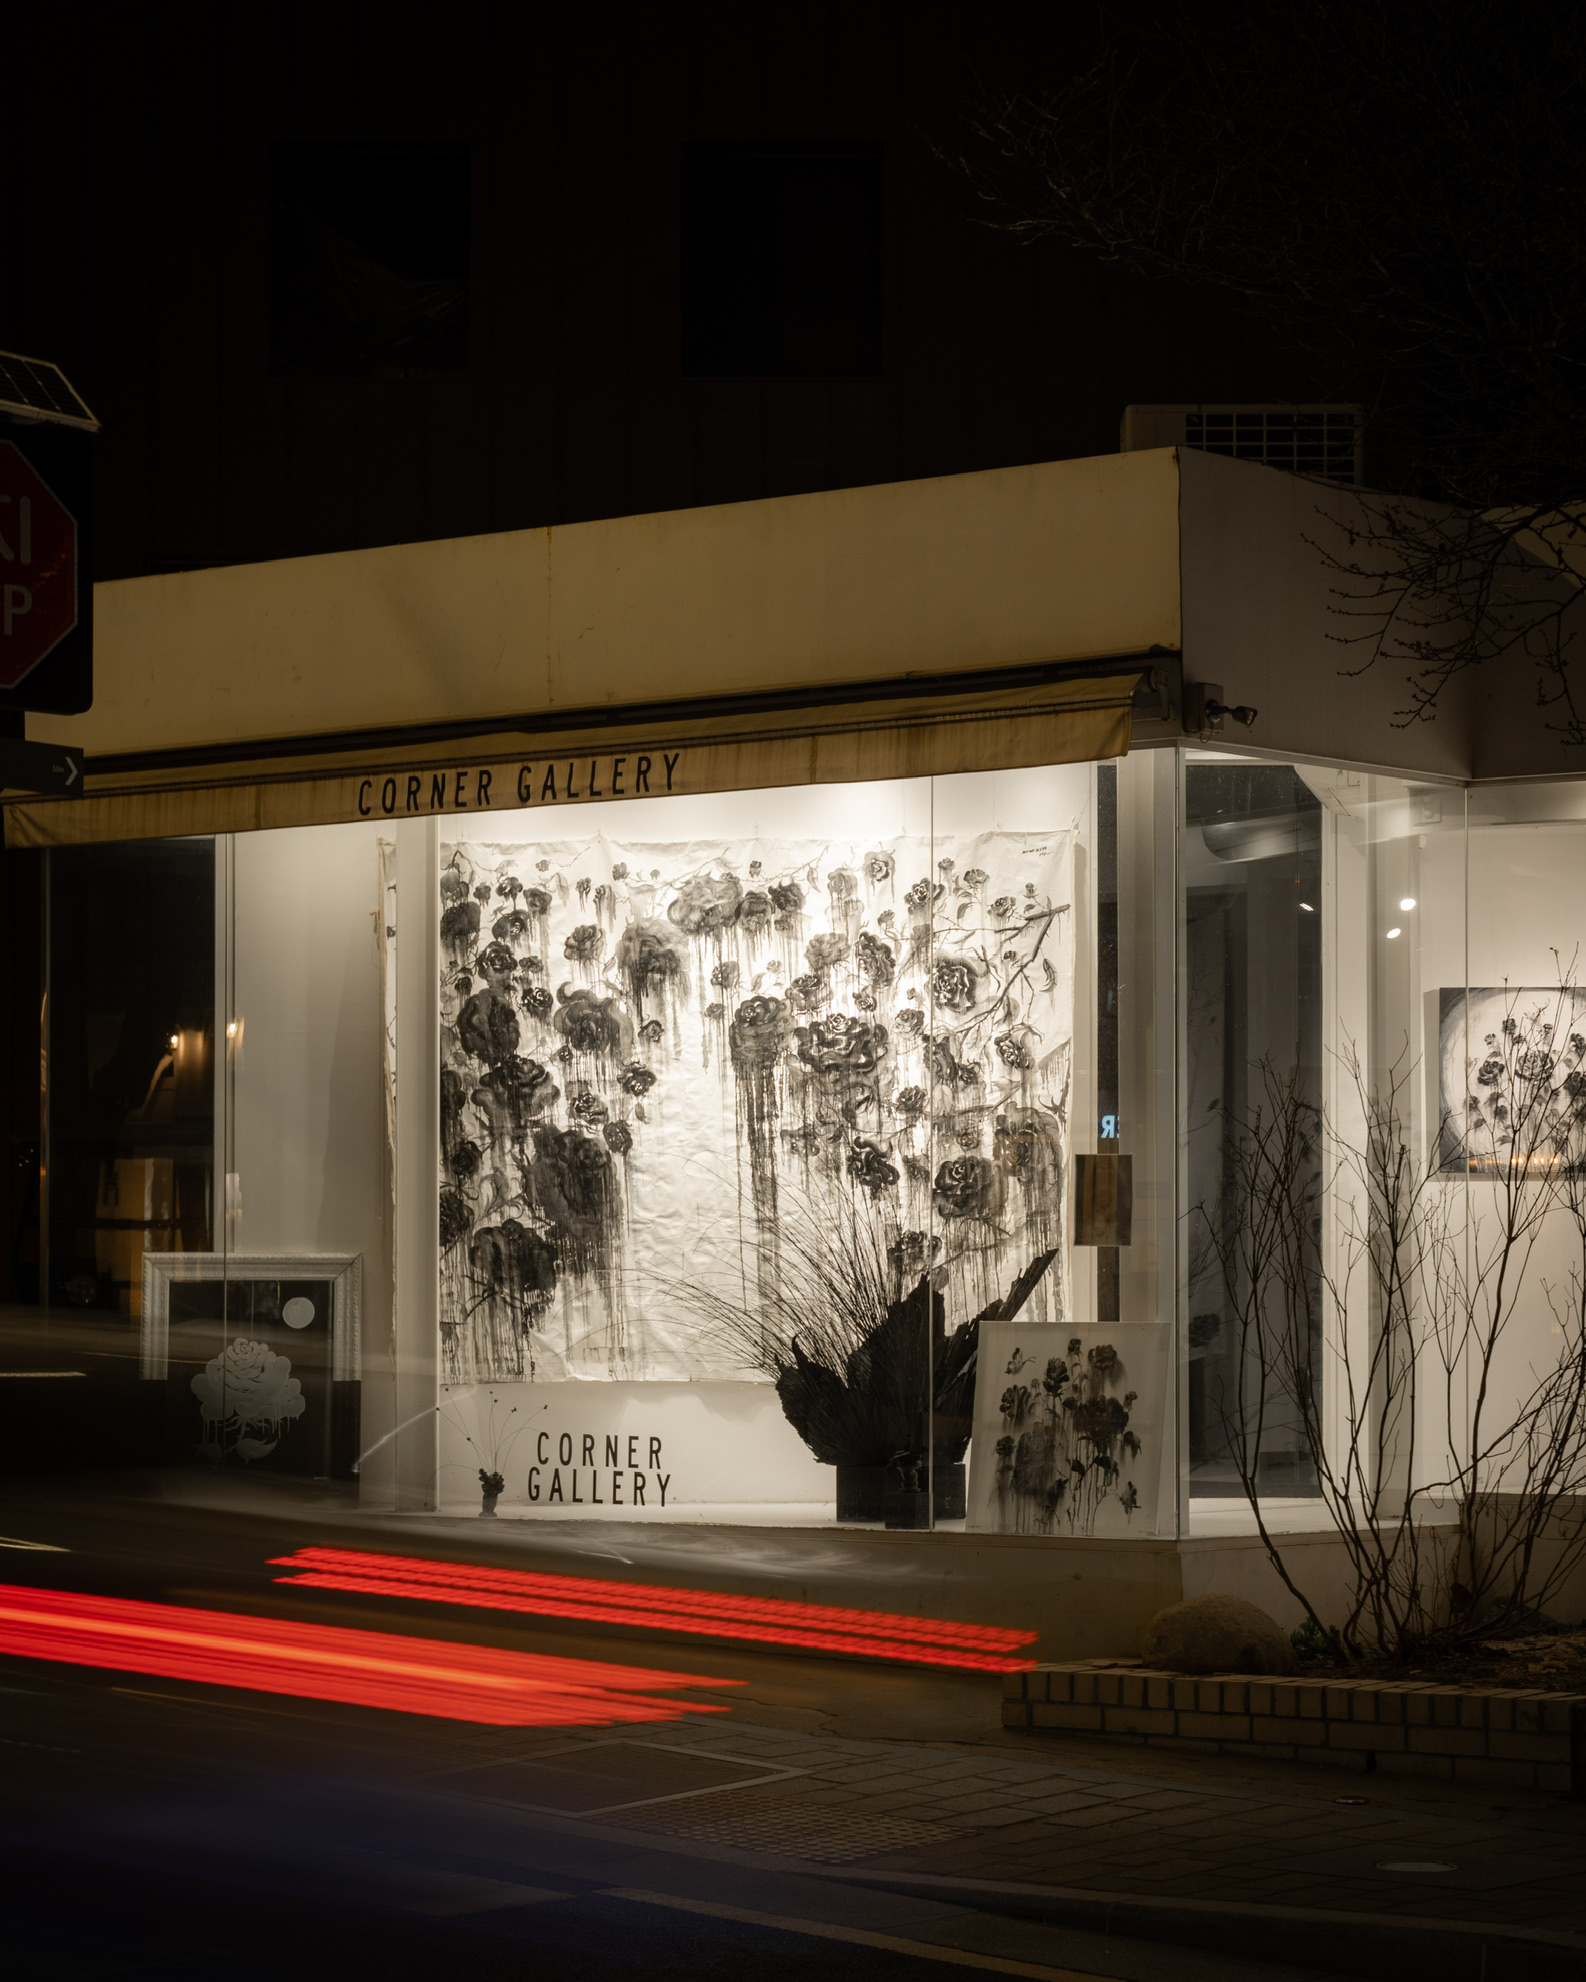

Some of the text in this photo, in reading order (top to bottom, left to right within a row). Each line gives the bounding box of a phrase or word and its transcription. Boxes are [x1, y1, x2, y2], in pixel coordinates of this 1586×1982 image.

[358, 752, 680, 816] CORNER GALLERY
[537, 1431, 662, 1470] CORNER
[528, 1466, 671, 1507] GALLERY
